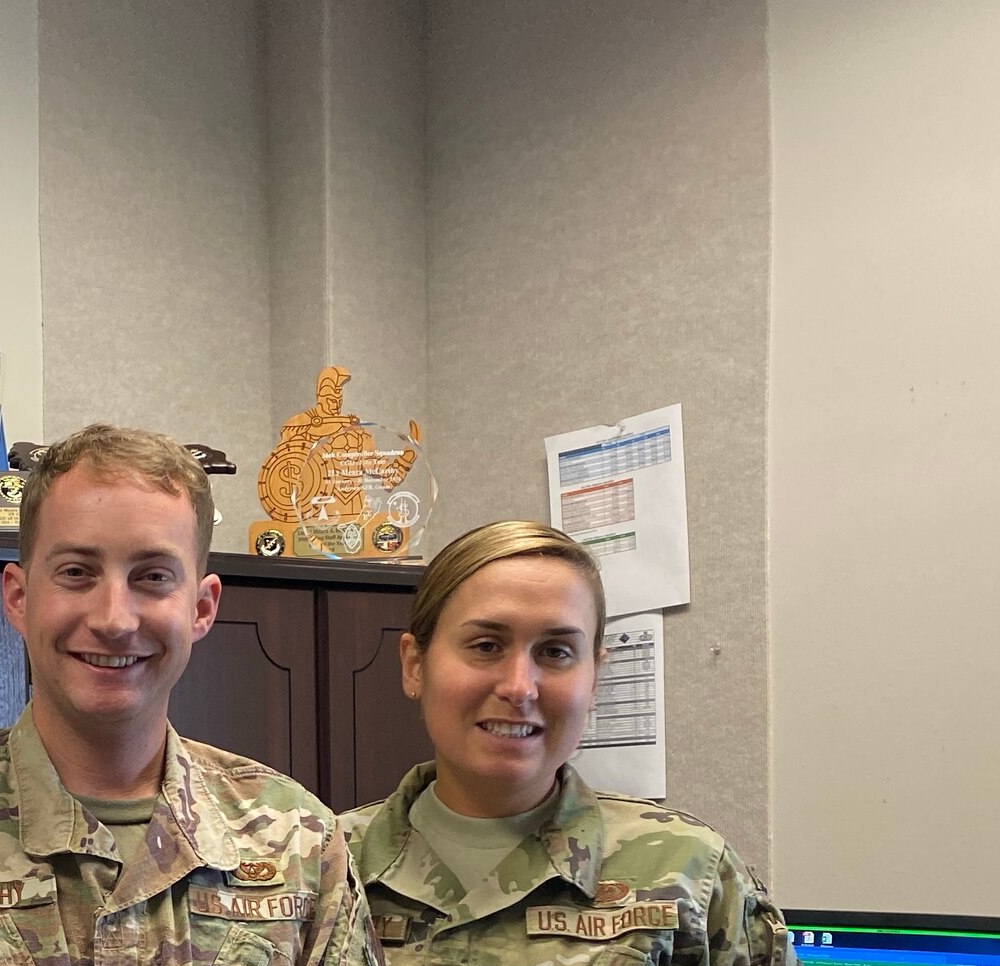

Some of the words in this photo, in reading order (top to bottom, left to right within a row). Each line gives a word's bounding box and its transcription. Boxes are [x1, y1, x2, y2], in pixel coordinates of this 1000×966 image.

[231, 896, 263, 919] AIR
[537, 910, 571, 934] U.S.
[575, 914, 606, 937] AIR
[611, 904, 677, 935] FORCE
